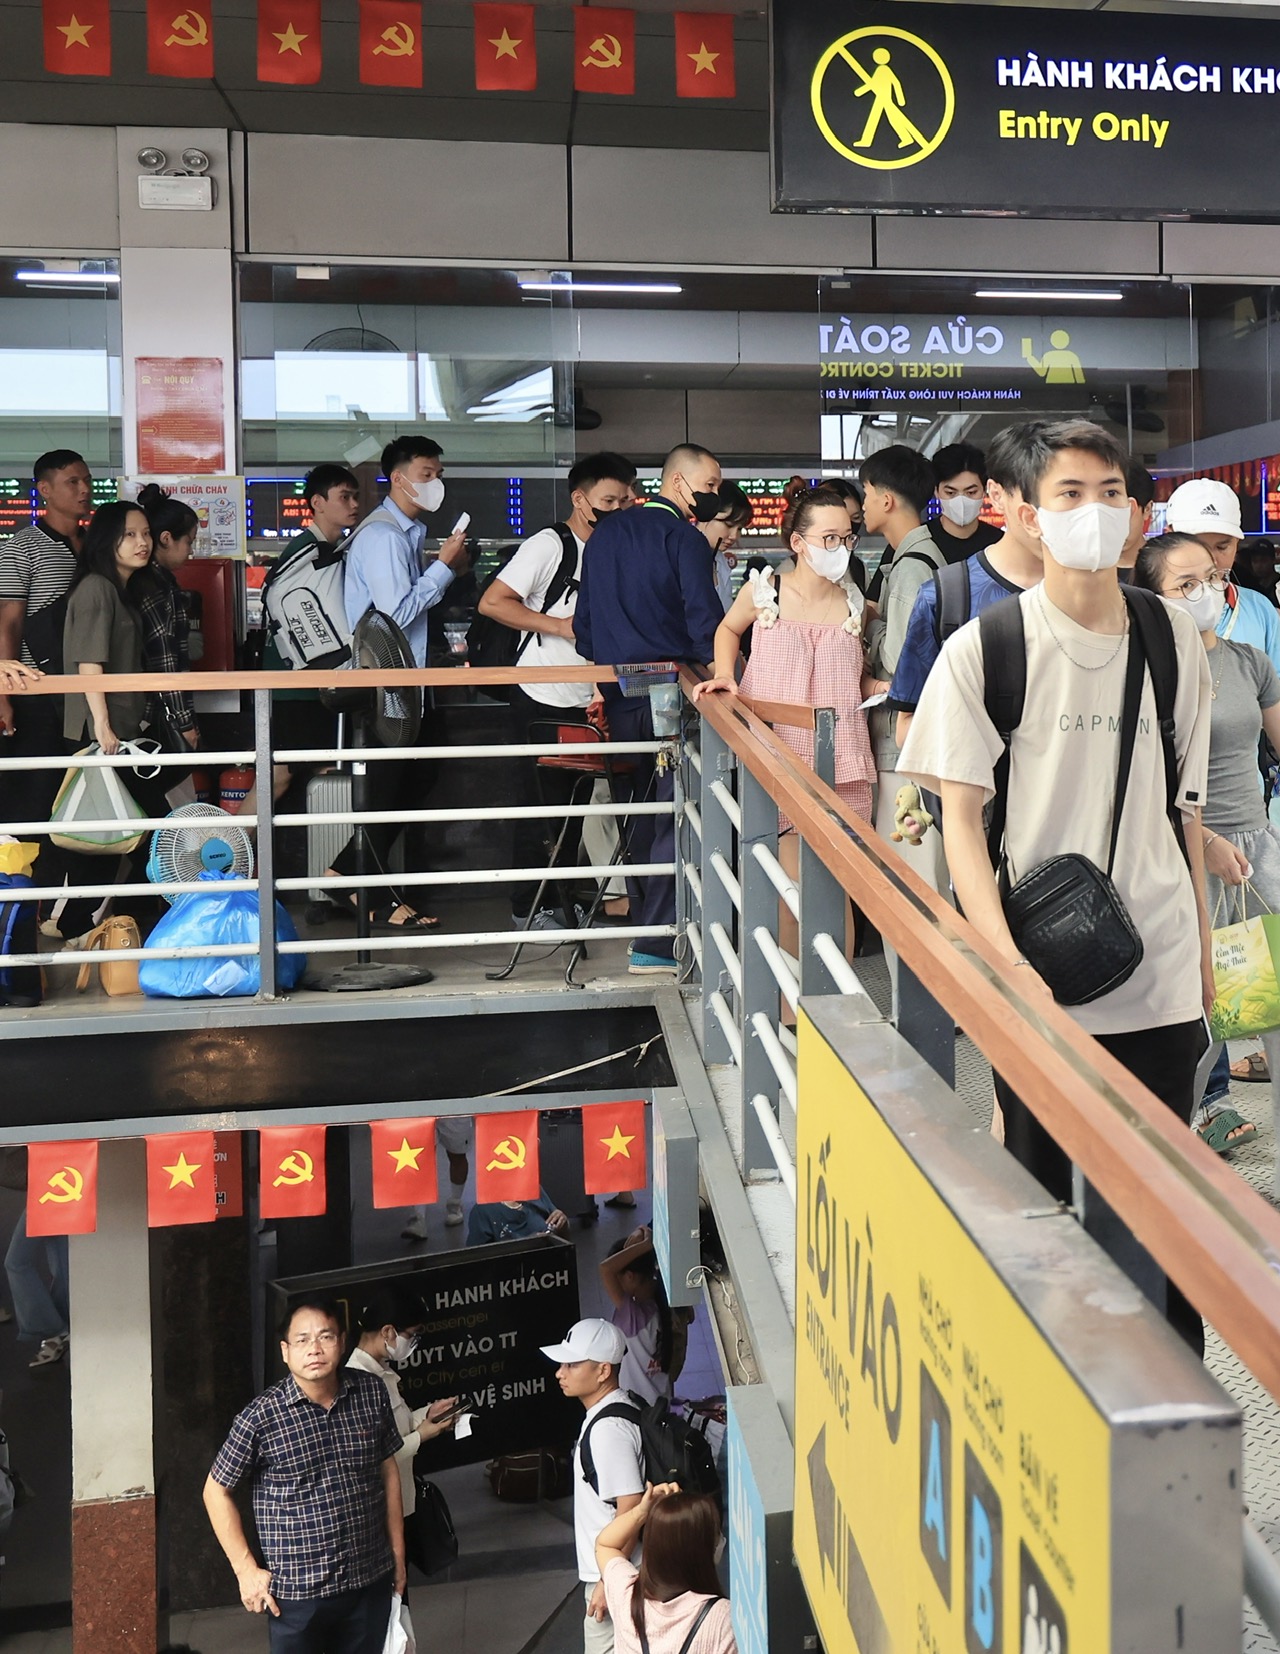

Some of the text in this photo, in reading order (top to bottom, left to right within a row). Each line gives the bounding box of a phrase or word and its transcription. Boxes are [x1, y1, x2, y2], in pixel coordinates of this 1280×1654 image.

[998, 52, 1093, 88] HÀNH
[1105, 57, 1221, 92] KHÁCH
[999, 110, 1170, 148] Entry Only
[1059, 714, 1149, 734] CAPMN
[499, 1269, 569, 1298] KHÁCH
[806, 1132, 902, 1445] LỐI VÀO
[450, 1335, 494, 1359] VÀO
[499, 1331, 518, 1349] TT
[806, 1290, 850, 1434] ENTRANCE
[473, 1383, 497, 1409] VỆ
[502, 1377, 546, 1400] SINH
[925, 1418, 947, 1562] A
[972, 1493, 994, 1649] B
